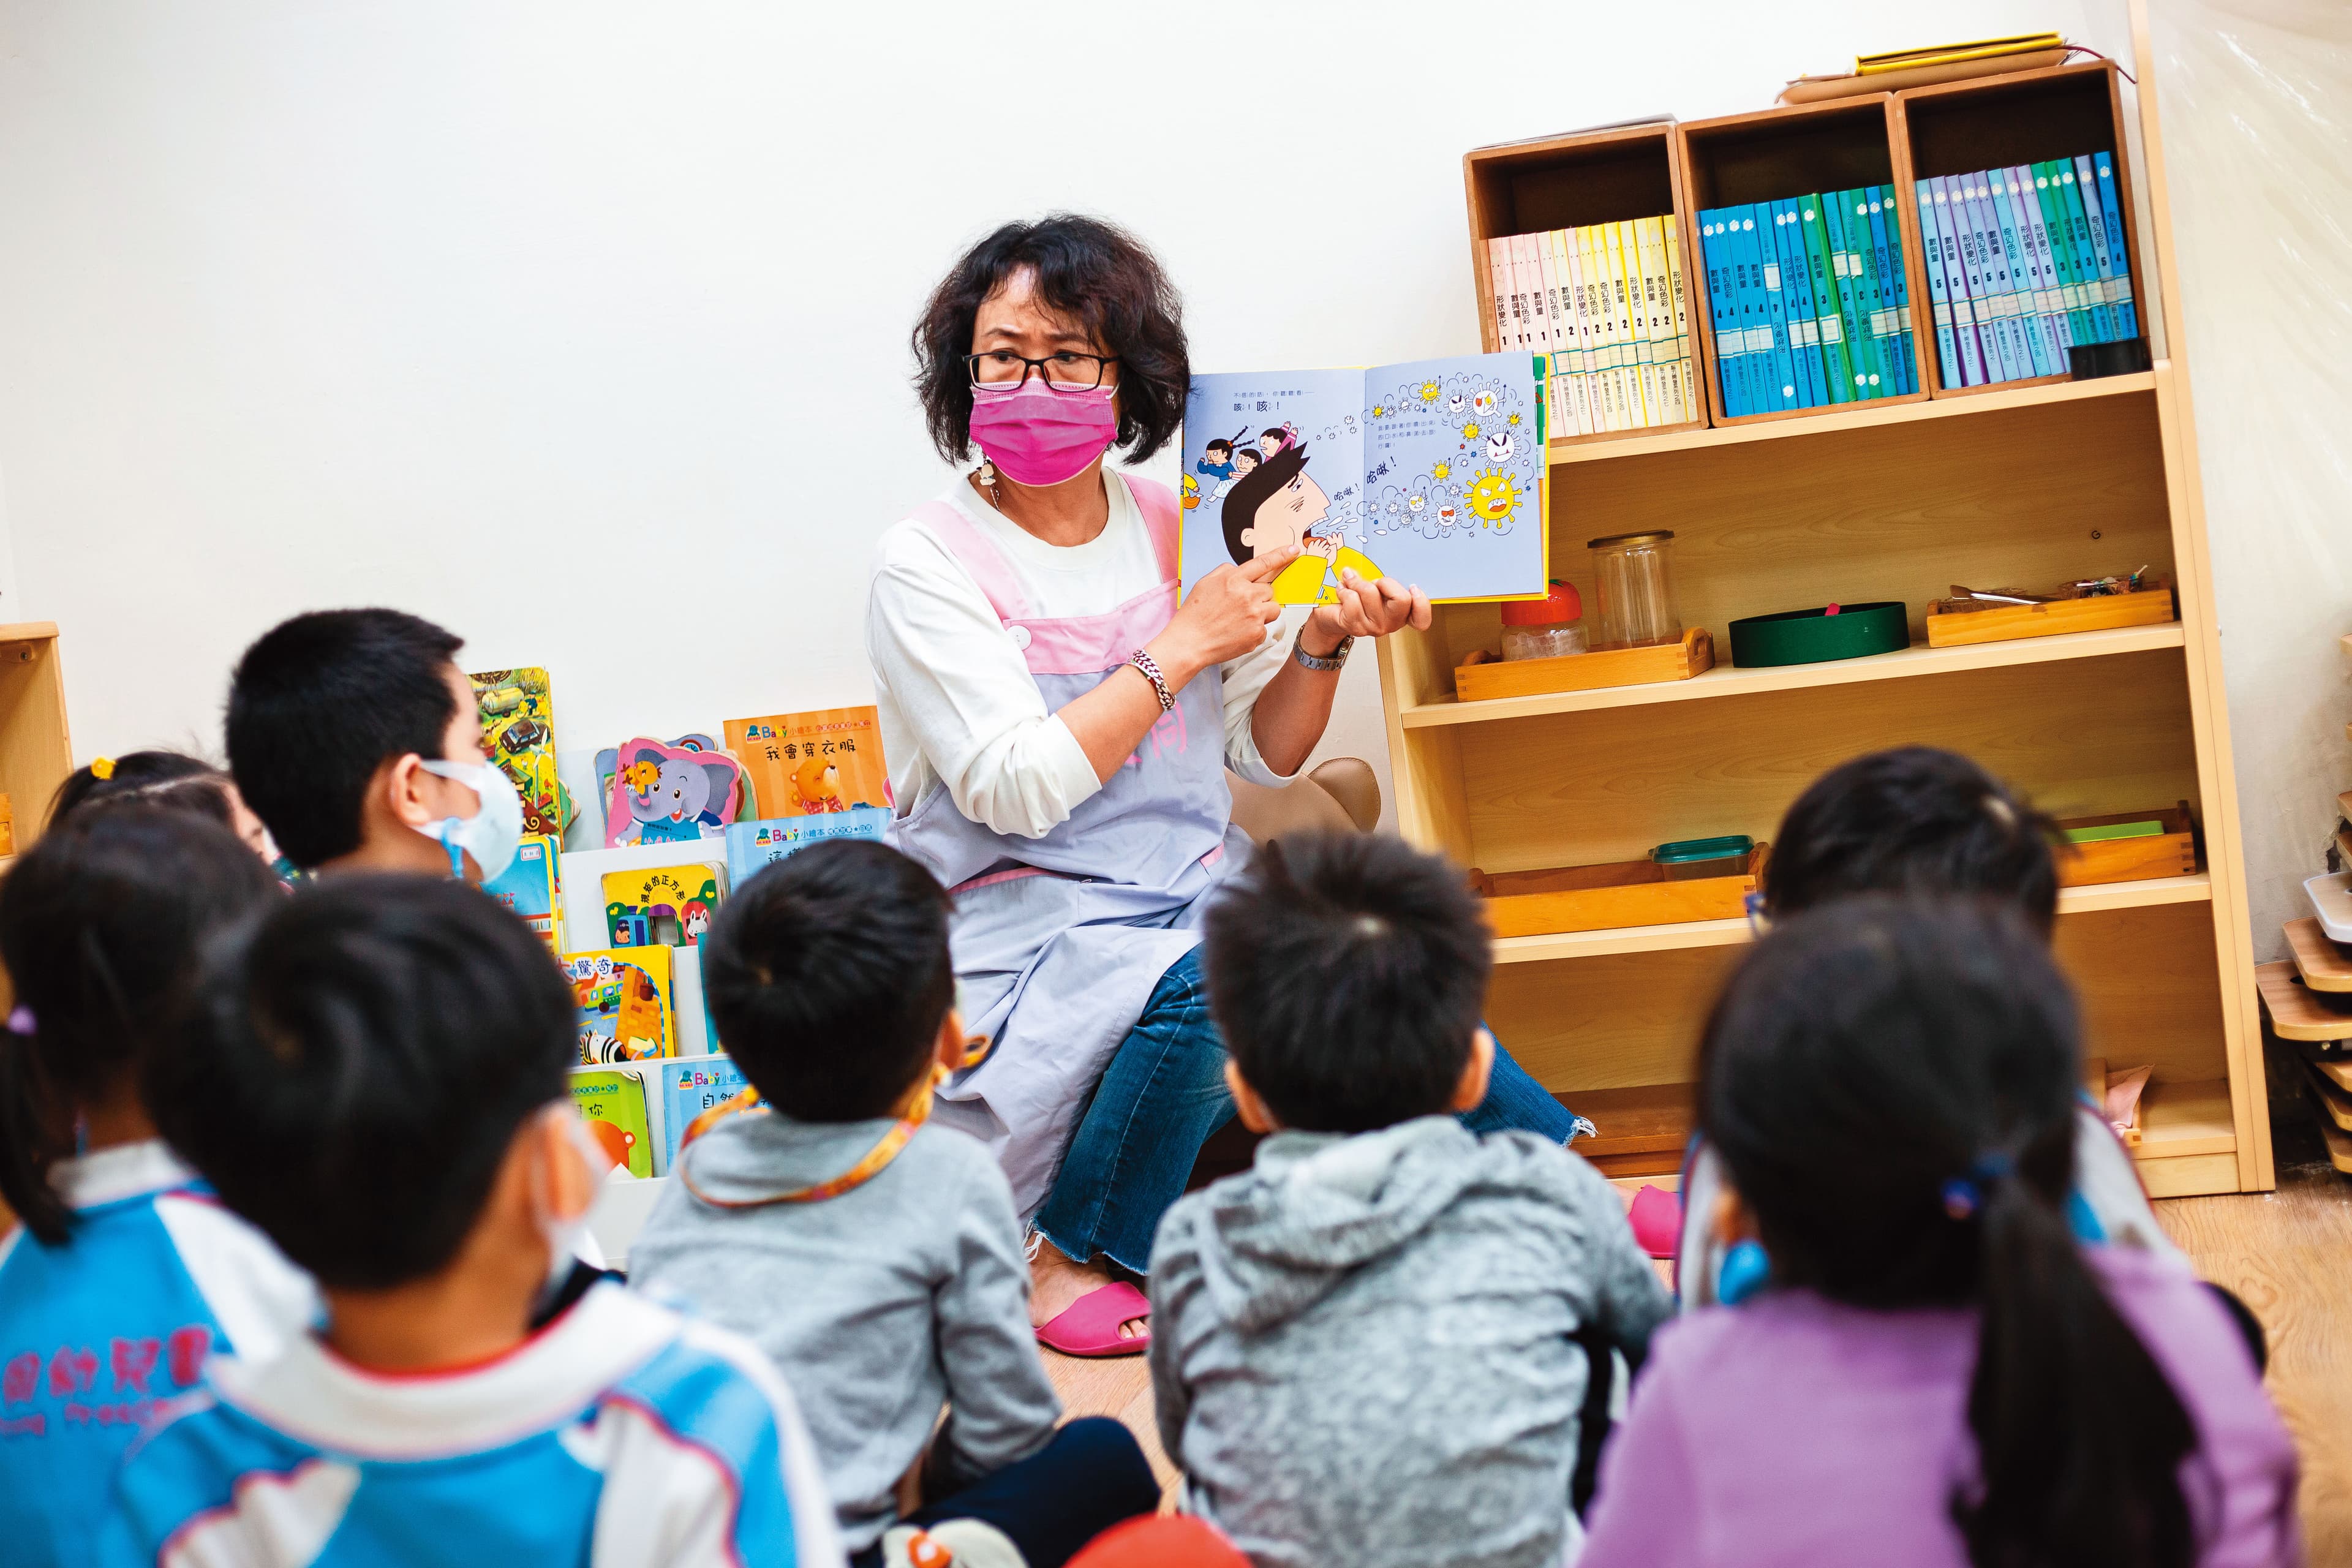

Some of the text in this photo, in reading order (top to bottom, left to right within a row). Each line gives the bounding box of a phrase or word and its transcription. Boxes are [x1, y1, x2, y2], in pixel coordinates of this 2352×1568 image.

[1929, 238, 1939, 262] 數與量
[1936, 279, 1941, 288] 5
[1944, 236, 1955, 261] 數與量
[1953, 277, 1959, 287] 5
[1962, 234, 1977, 266] 形狀變化
[1973, 276, 1978, 285] 5
[1975, 232, 1989, 264] 奇幻色彩
[1986, 272, 1991, 282] 5
[1988, 230, 2000, 255] 數與量
[1999, 271, 2005, 281] 5
[2003, 227, 2018, 260] 奇幻色彩
[2015, 268, 2020, 277] 5
[2021, 225, 2035, 258] 形狀變化
[2031, 267, 2037, 276] 5
[2034, 223, 2049, 256] 形狀變化
[2046, 265, 2051, 274] 5
[2075, 260, 2081, 269] 3
[2086, 257, 2092, 266] 3
[2092, 216, 2105, 249] 奇幻色彩
[2101, 257, 2107, 266] 5
[1737, 265, 1747, 288] 數與量
[1745, 304, 1749, 314] 4
[1751, 264, 1760, 288] 數與量
[1759, 304, 1763, 313] 4
[1784, 257, 1795, 290] 形狀變化
[1791, 299, 1795, 308] 4
[1795, 255, 1806, 287] 形狀變化
[1802, 296, 1807, 306] 4
[1813, 255, 1823, 279] 數與量
[1821, 295, 1826, 304] 3
[1898, 283, 1903, 292] 3
[2060, 262, 2065, 271] 3
[1548, 288, 1559, 320] 奇幻色彩
[1556, 329, 1560, 337] 1
[1561, 287, 1571, 310] 數與量
[1569, 326, 1574, 335] 2
[1576, 286, 1588, 317] 形狀變化
[1583, 327, 1588, 336] 1
[1588, 284, 1599, 315] 奇幻色彩
[1595, 325, 1600, 333] 2
[1600, 282, 1611, 314] 奇幻色彩
[1607, 322, 1612, 331] 2
[1615, 279, 1625, 303] 數與量
[1623, 320, 1627, 328] 2
[1630, 277, 1641, 309] 形狀變化
[1637, 318, 1642, 326] 2
[1646, 277, 1656, 301] 數與量
[1653, 317, 1658, 326] 2
[1657, 276, 1668, 307] 奇幻色彩
[1664, 316, 1670, 325] 2
[1673, 271, 1684, 303] 形狀變化
[1679, 312, 1684, 321] 2
[1710, 270, 1720, 293] 數與量
[1717, 309, 1722, 318] 4
[1722, 267, 1733, 299] 奇幻色彩
[1730, 307, 1734, 316] 4
[1873, 289, 1879, 298] 3
[1885, 287, 1890, 296] 4
[1496, 295, 1507, 345] 形狀變化 1
[1511, 295, 1522, 343] 數與量 1
[1520, 293, 1531, 342] 奇幻色彩 1
[1534, 292, 1544, 315] 數與量
[1541, 331, 1545, 341] 1
[762, 725, 787, 739] Baby
[765, 739, 856, 761] 我會穿衣服
[772, 828, 799, 842] Baby
[801, 829, 824, 839] 小繪本
[641, 875, 685, 903] 規矩的正方形
[695, 1072, 720, 1085] Baby
